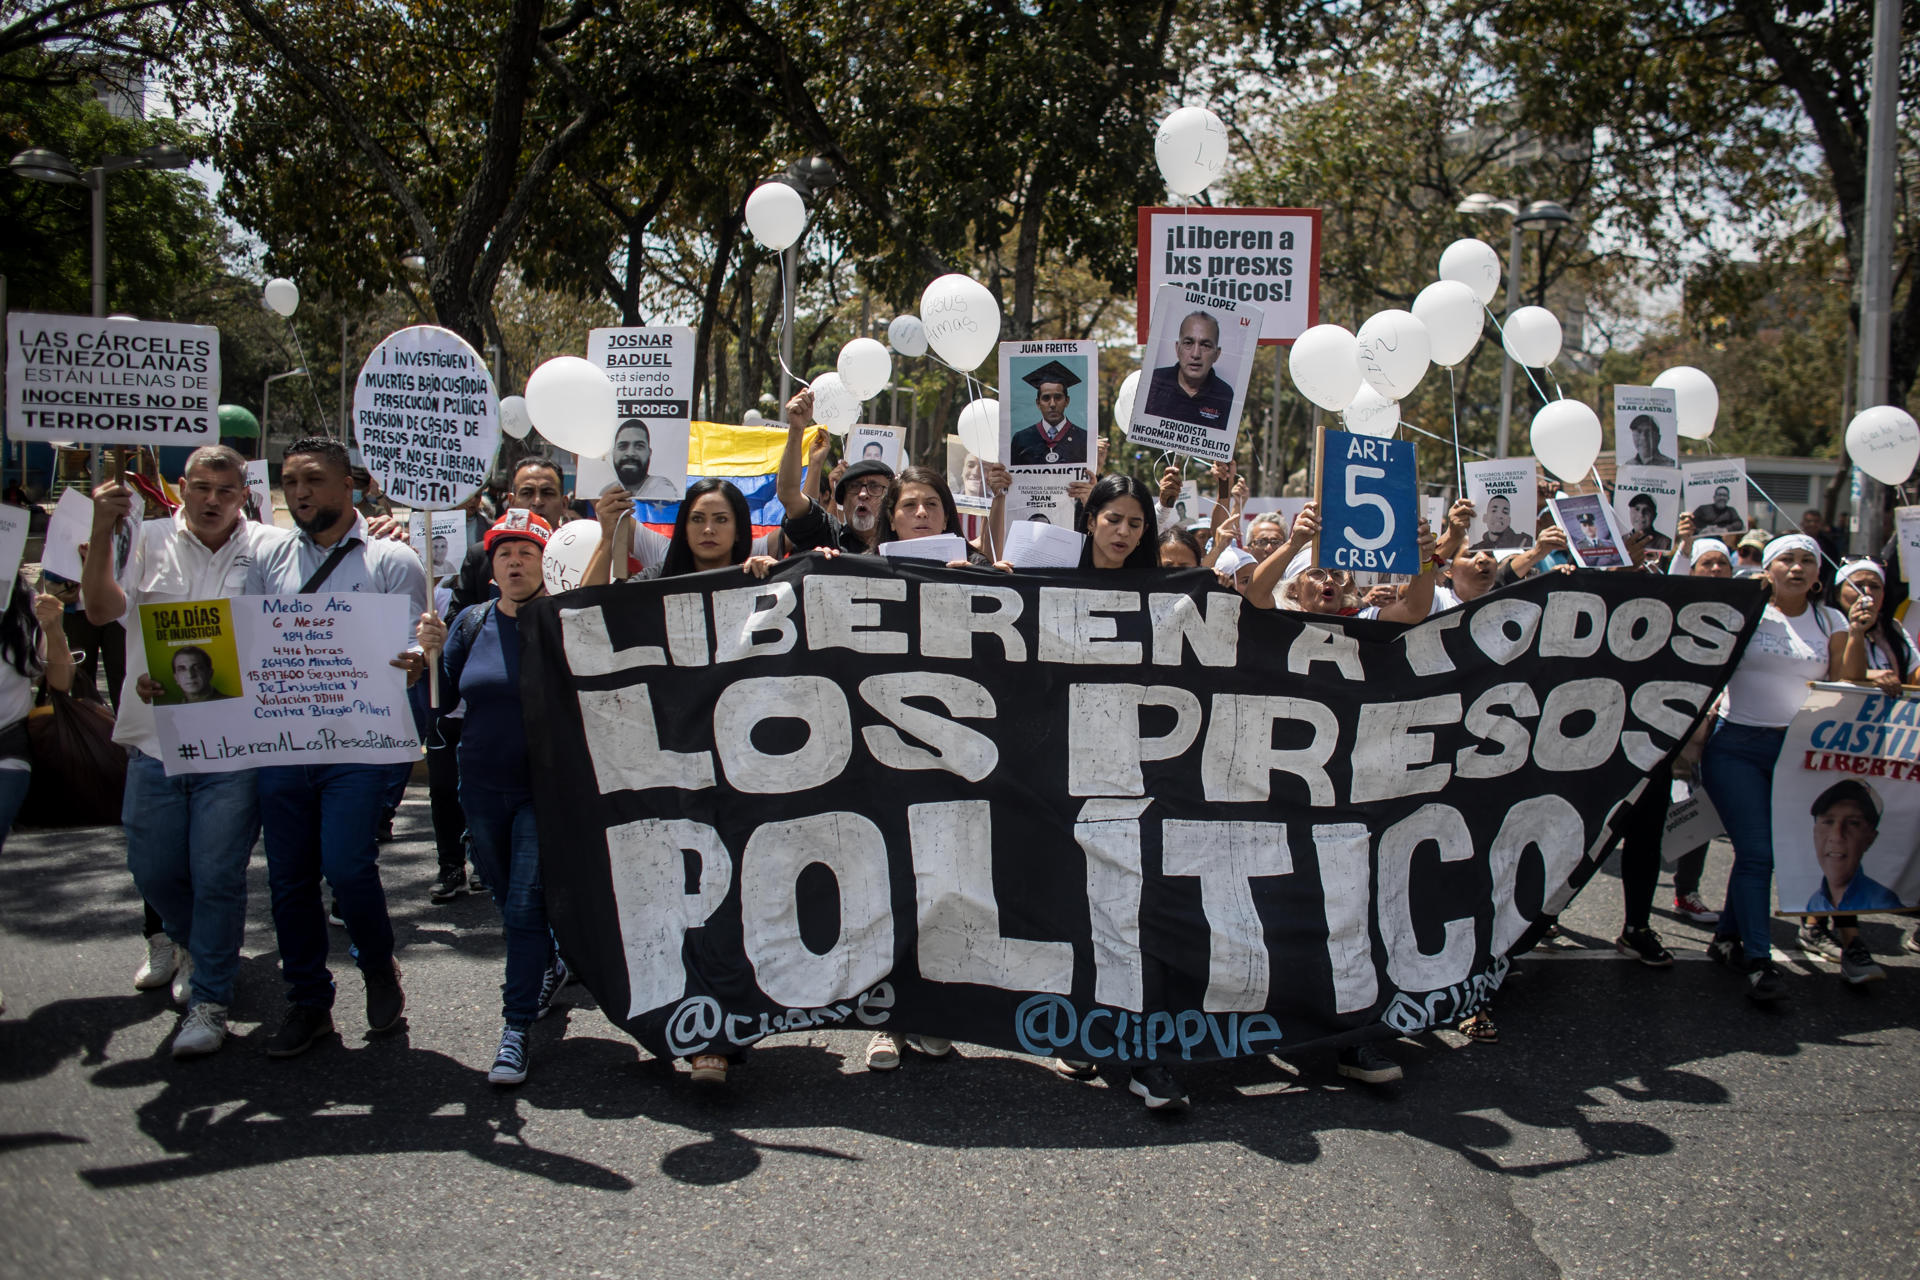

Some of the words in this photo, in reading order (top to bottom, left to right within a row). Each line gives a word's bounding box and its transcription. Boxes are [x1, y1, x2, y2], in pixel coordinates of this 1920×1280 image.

[1167, 226, 1273, 251] ¡Liberen
[1279, 231, 1294, 250] a
[1165, 252, 1202, 275] lxs
[1208, 257, 1293, 277] presxs
[1168, 278, 1292, 302] líticos!
[1185, 292, 1206, 305] LUIS
[1207, 297, 1237, 311] LOPEZ
[19, 330, 69, 348] LAS
[77, 331, 210, 356] CÁRCELES
[608, 334, 673, 348] JOSNAR
[1020, 344, 1043, 353] JUAN
[1045, 343, 1078, 353] FREITES
[22, 348, 208, 373] VENEZOLANAS
[607, 353, 672, 367] BADUEL
[24, 367, 93, 384] ESTÁN
[100, 371, 176, 388] LLENAS
[182, 376, 209, 390] DE
[365, 373, 415, 390] MUERTES
[629, 371, 670, 382] siendo
[22, 389, 140, 407] INOCENTES
[146, 394, 176, 408] NO
[182, 396, 208, 410] DE
[616, 384, 674, 397] rturado
[632, 404, 679, 415] RODEO
[22, 411, 209, 433] TERRORISTAS
[464, 420, 479, 436] DE
[1160, 419, 1207, 437] PERIODISTA
[363, 427, 409, 445] PRESOS
[859, 429, 894, 438] LIBERTAD
[1132, 424, 1175, 441] INFORMAR
[1176, 432, 1189, 443] NO
[1190, 436, 1200, 446] ES
[1201, 439, 1231, 452] DELITO
[363, 443, 402, 461] PORQUE
[1347, 437, 1394, 462] ART.
[371, 458, 390, 473] LOS
[394, 461, 434, 479] PRESOS
[1641, 486, 1676, 495] CASTILLO
[1344, 464, 1396, 551] 5
[1335, 548, 1396, 570] CRBV
[263, 599, 313, 614] Medio
[152, 610, 179, 629] 184
[183, 606, 221, 627] DÍAS
[294, 617, 334, 628] Meses
[156, 629, 168, 641] DE
[169, 625, 222, 641] INJUSTICIA
[283, 632, 303, 641] 184
[305, 630, 333, 641] días
[559, 575, 1243, 676] LIBEREN
[1288, 620, 1366, 681] A
[1391, 591, 1745, 677] TODOS
[304, 645, 344, 656] horas
[262, 657, 304, 669] 264960
[309, 656, 353, 667] Minutos
[307, 667, 369, 681] Segundos
[256, 693, 310, 706] Violación
[313, 693, 345, 704] DDHH
[254, 706, 305, 719] Contra
[1856, 694, 1920, 727] EXA
[577, 671, 999, 795] LOS
[1068, 677, 1713, 807] PRESOS
[1810, 720, 1920, 761] CASTIL
[606, 775, 1650, 1020] POLÍTICO
